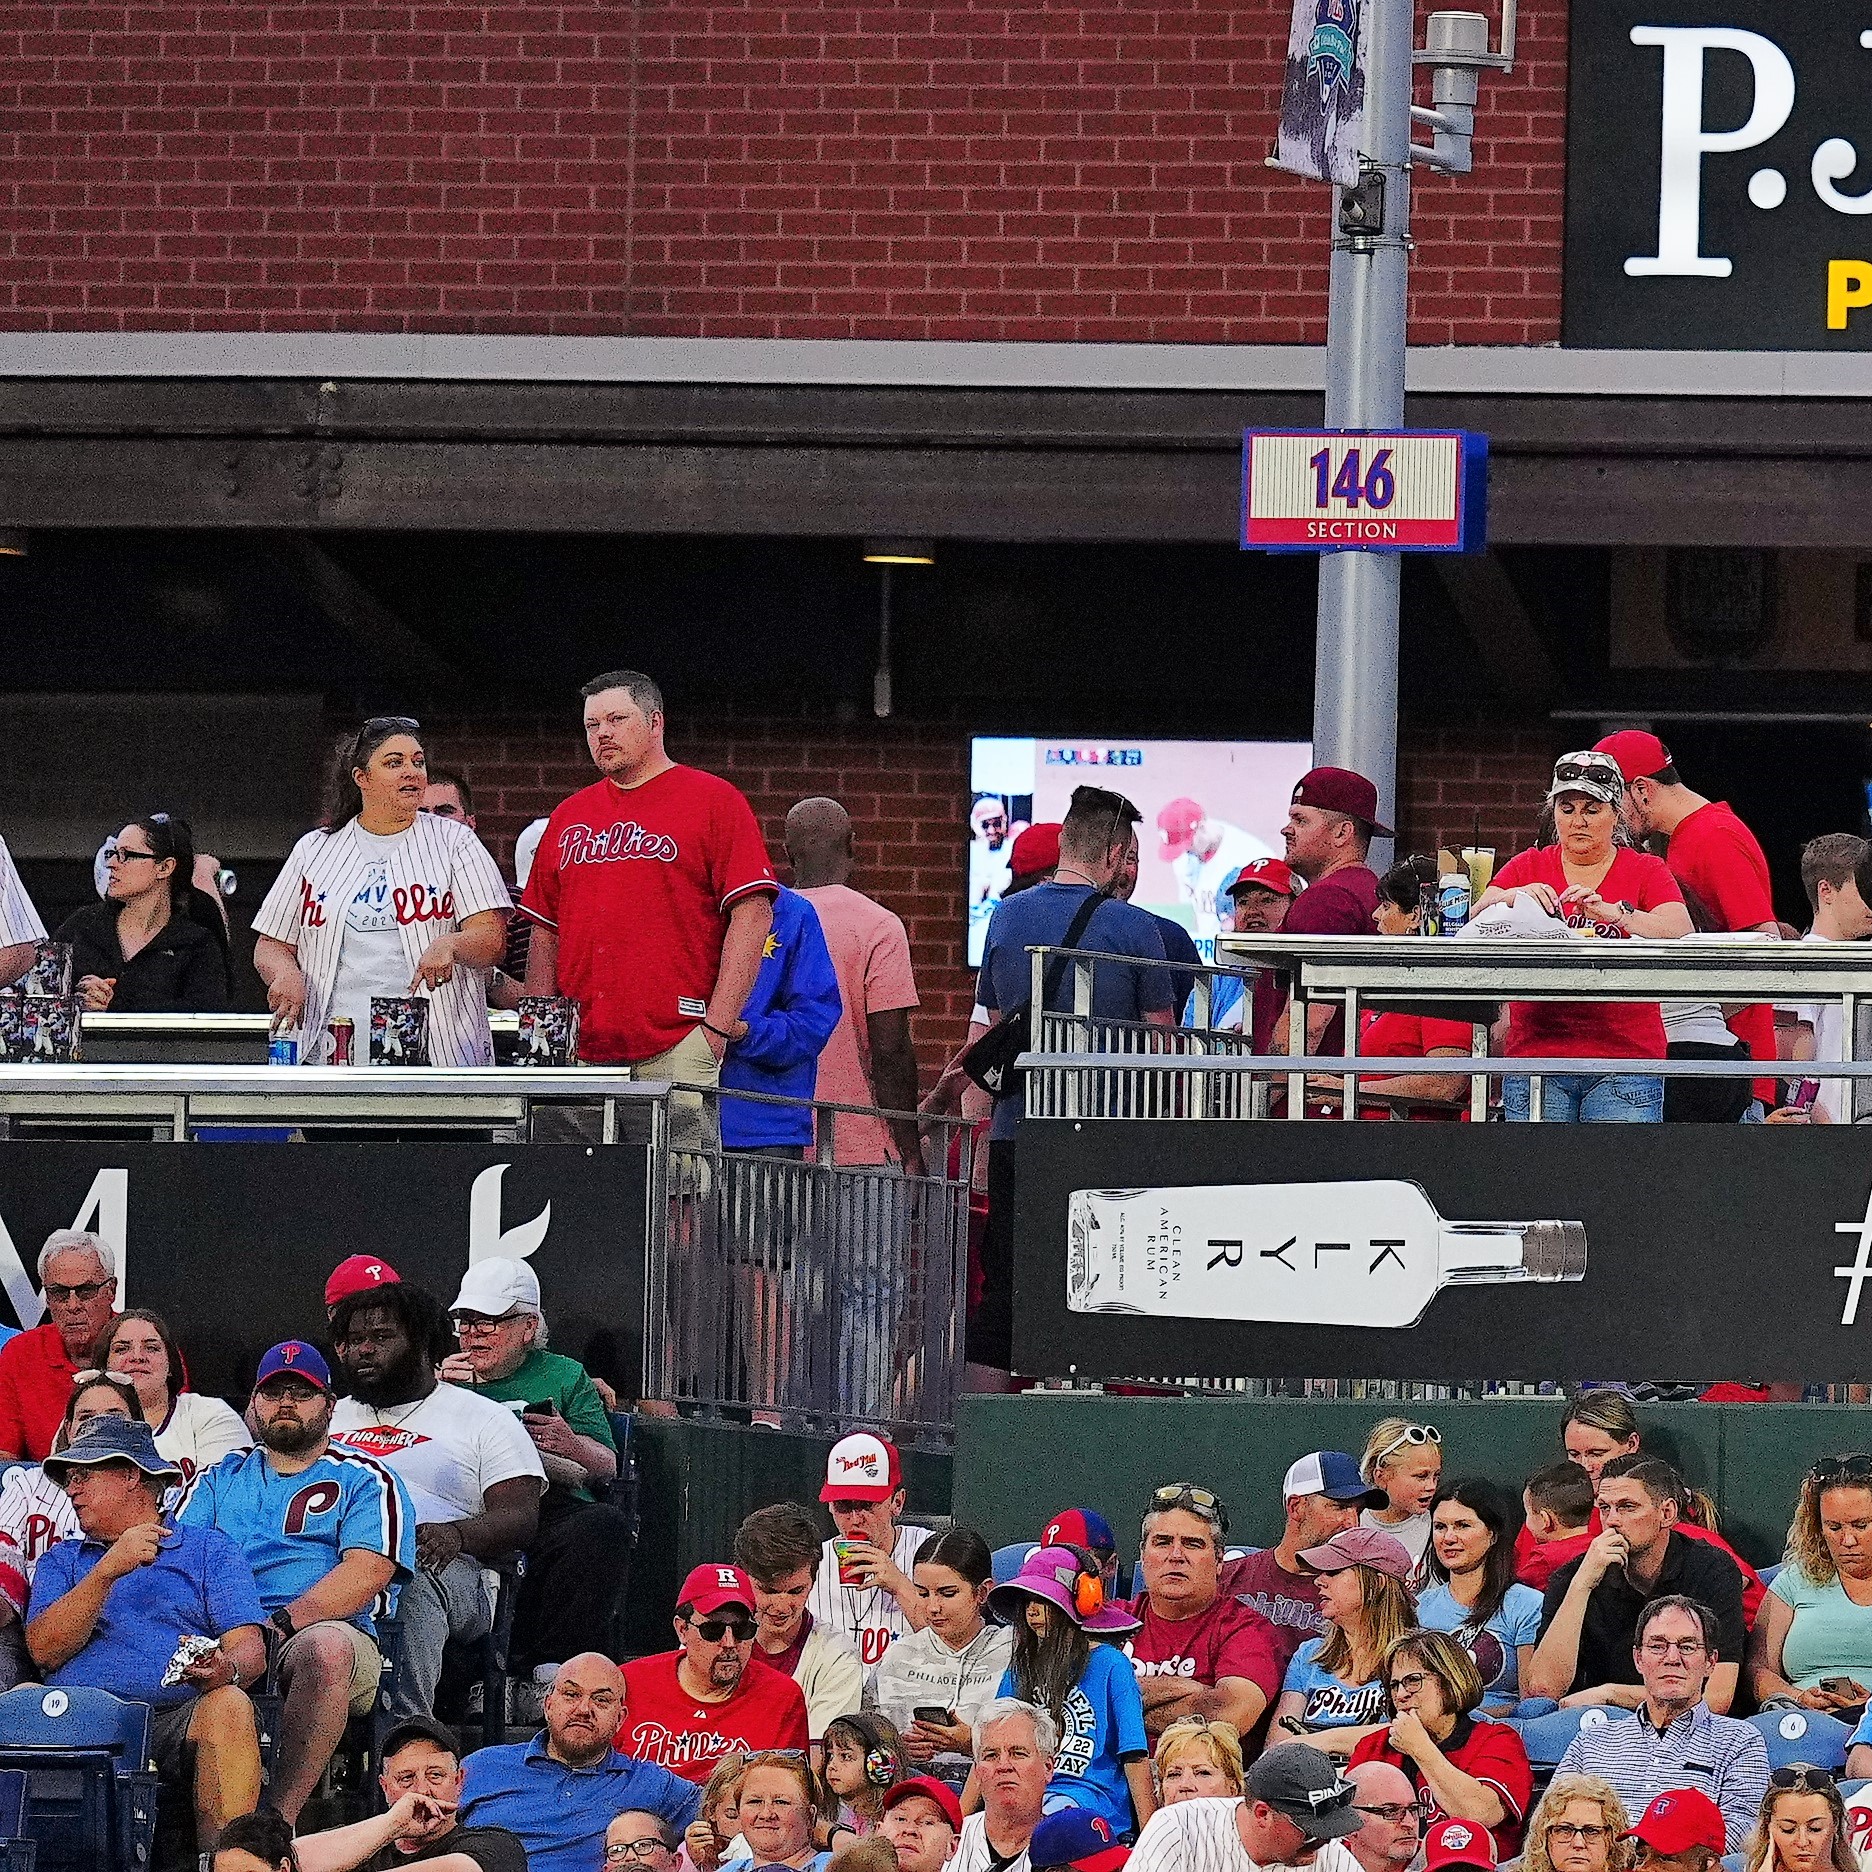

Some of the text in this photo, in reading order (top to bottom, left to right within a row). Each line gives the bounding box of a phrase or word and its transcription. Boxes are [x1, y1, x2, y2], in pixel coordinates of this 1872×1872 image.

[1309, 446, 1397, 509] 146
[1307, 521, 1398, 540] SECTION
[558, 822, 678, 870] Phillies
[1252, 858, 1270, 873] P
[1147, 1235, 1156, 1272] RUM
[1159, 1206, 1169, 1301] AMERICAN
[1172, 1225, 1182, 1282] CLEAN
[365, 1265, 382, 1281] P
[281, 1344, 300, 1364] P
[282, 1479, 342, 1536] P
[716, 1568, 737, 1583] R
[907, 1669, 992, 1687] PHILADELPHIA
